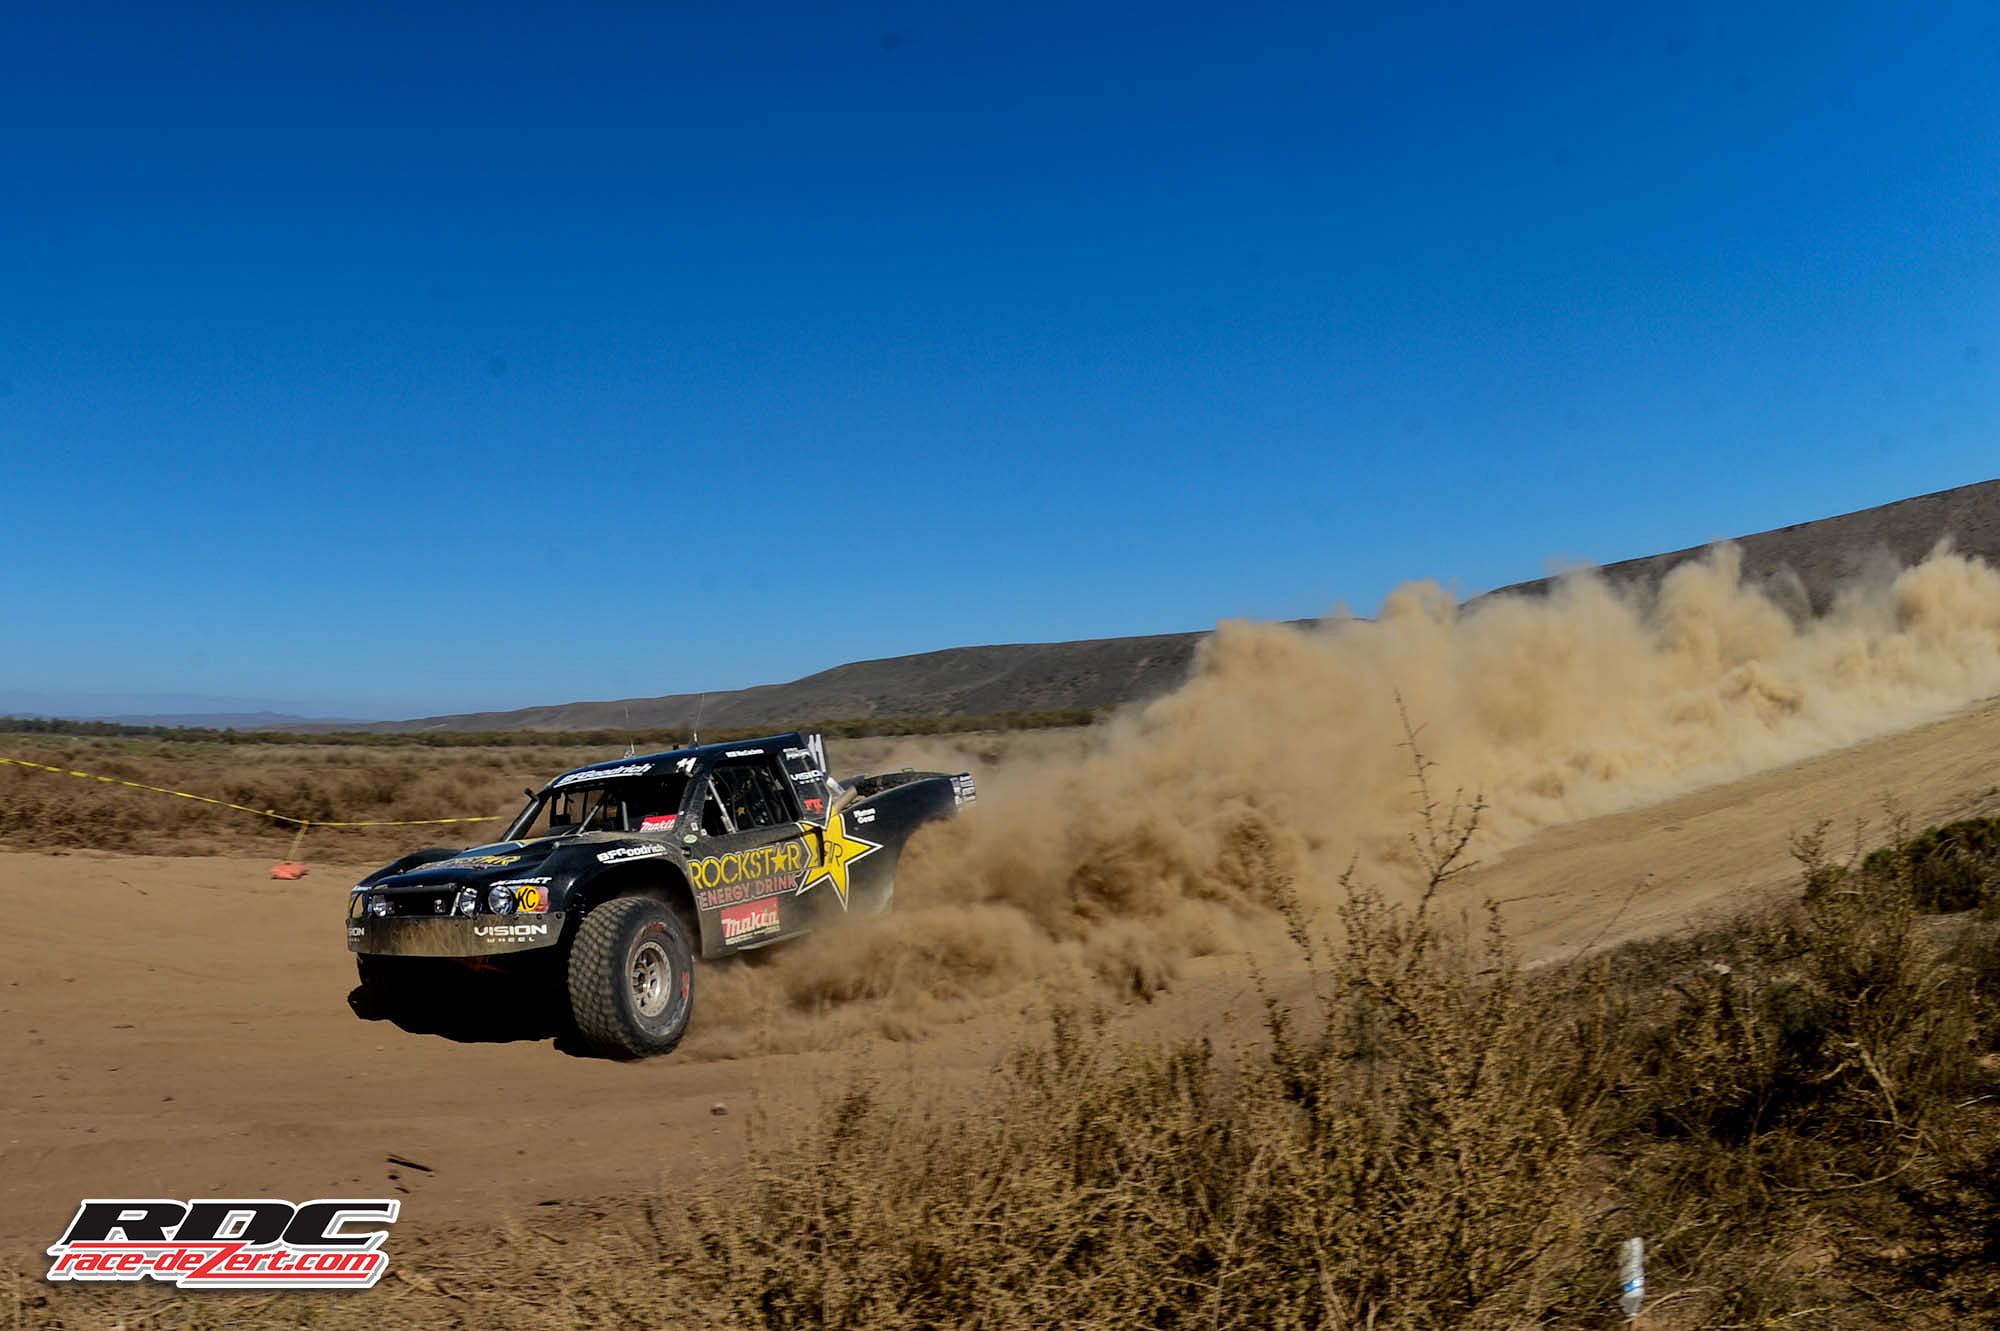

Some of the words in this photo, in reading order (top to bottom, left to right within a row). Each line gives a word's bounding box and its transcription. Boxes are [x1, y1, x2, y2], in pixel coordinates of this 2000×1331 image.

[555, 762, 653, 786] BFGoodrich
[596, 843, 668, 862] BFGoodrich
[515, 888, 537, 911] KC
[700, 882, 750, 909] ENERGY
[755, 874, 797, 893] DRINK
[473, 924, 548, 937] VISION
[486, 936, 536, 944] WHEEL
